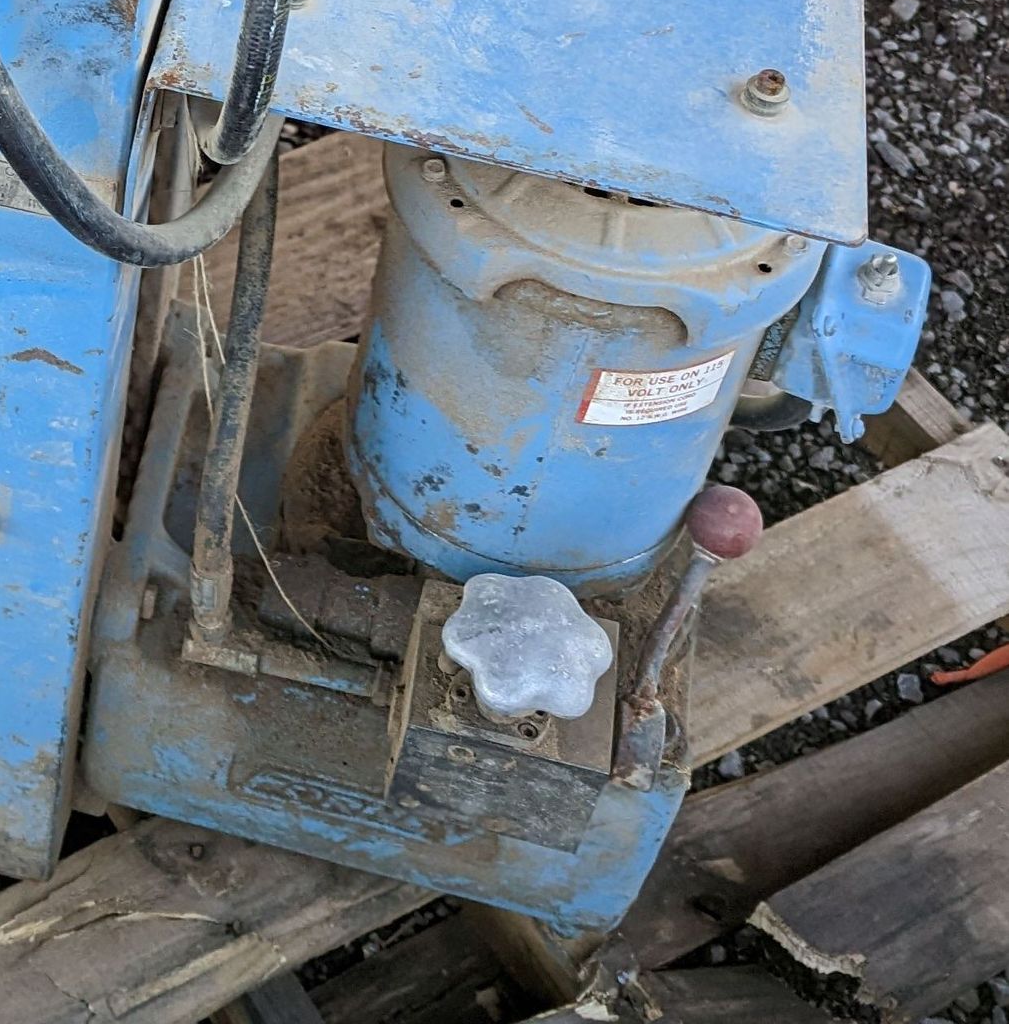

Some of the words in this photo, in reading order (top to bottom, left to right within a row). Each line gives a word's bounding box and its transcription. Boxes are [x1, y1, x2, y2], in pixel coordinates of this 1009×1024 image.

[613, 377, 643, 386] FOR
[649, 375, 677, 386] USE
[681, 369, 700, 381] ON
[704, 360, 724, 374] 115
[628, 387, 665, 397] VOLT
[669, 378, 703, 393] ONLY
